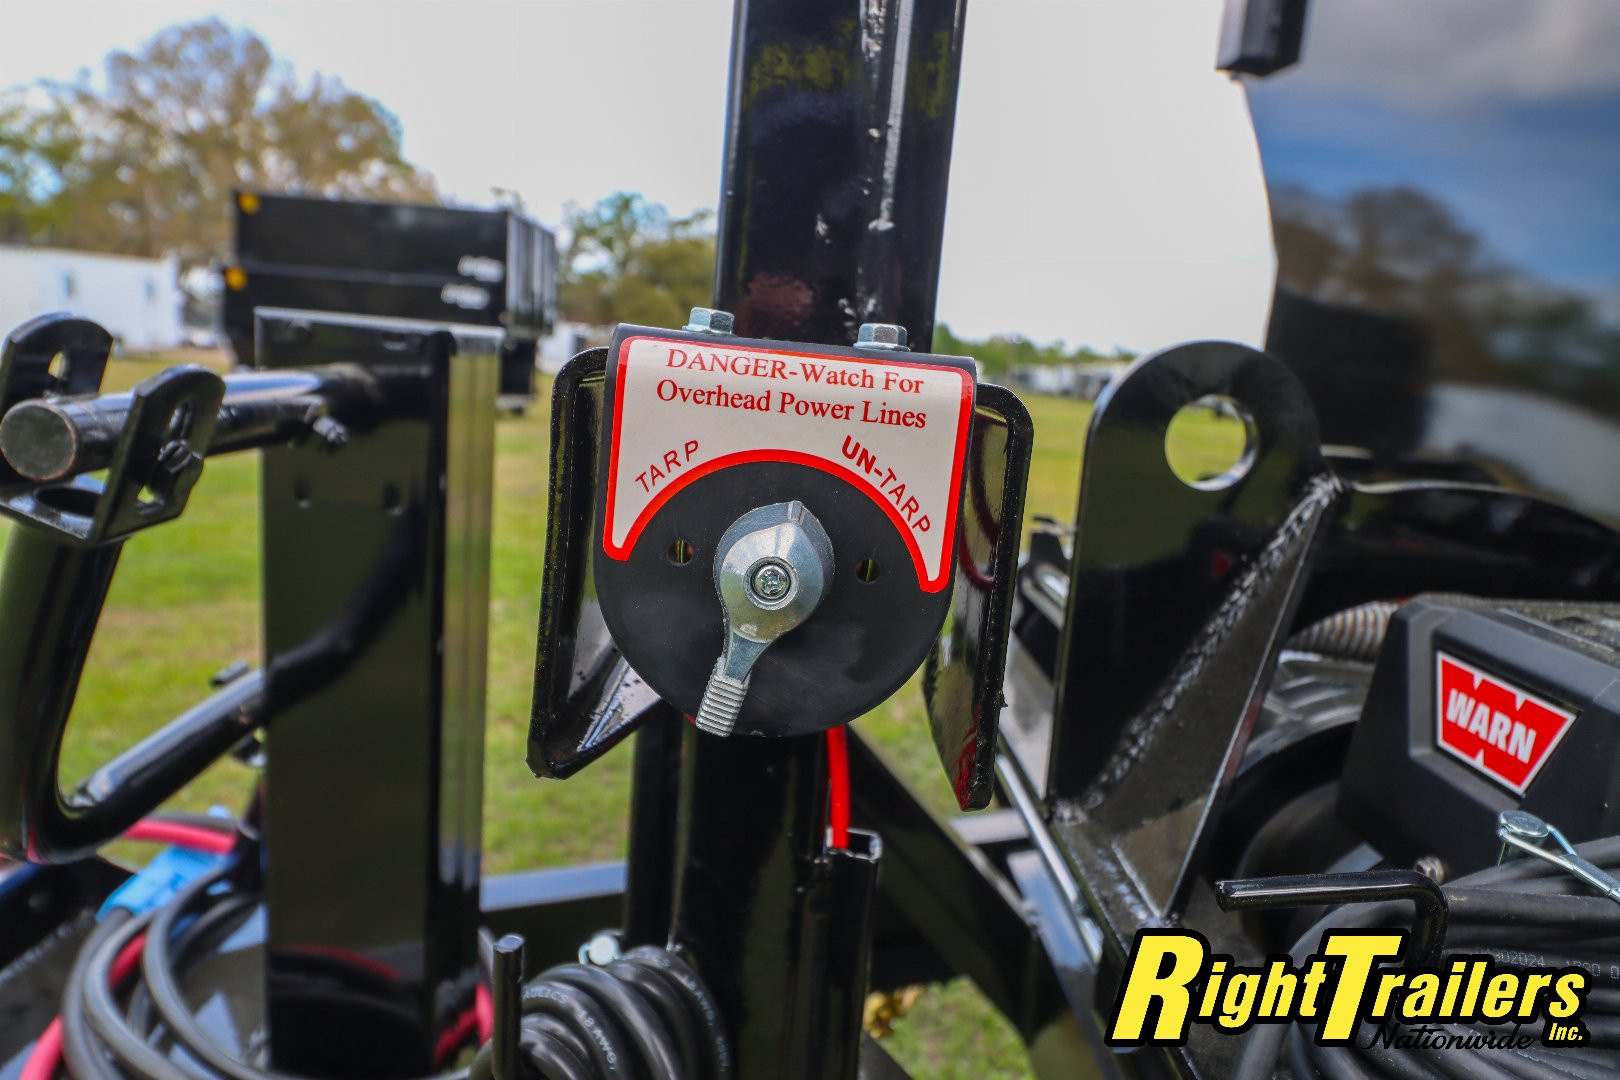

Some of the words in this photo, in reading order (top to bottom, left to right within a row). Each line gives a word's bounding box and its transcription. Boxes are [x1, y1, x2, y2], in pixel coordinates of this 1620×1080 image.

[667, 348, 875, 389] DANGER-Watch
[883, 371, 924, 394] For
[656, 379, 772, 412] Overhead
[779, 391, 856, 421] Power
[861, 400, 927, 428] Lines
[635, 440, 700, 493] TARP
[842, 434, 931, 533] UN-TARP
[1446, 688, 1537, 764] WARN
